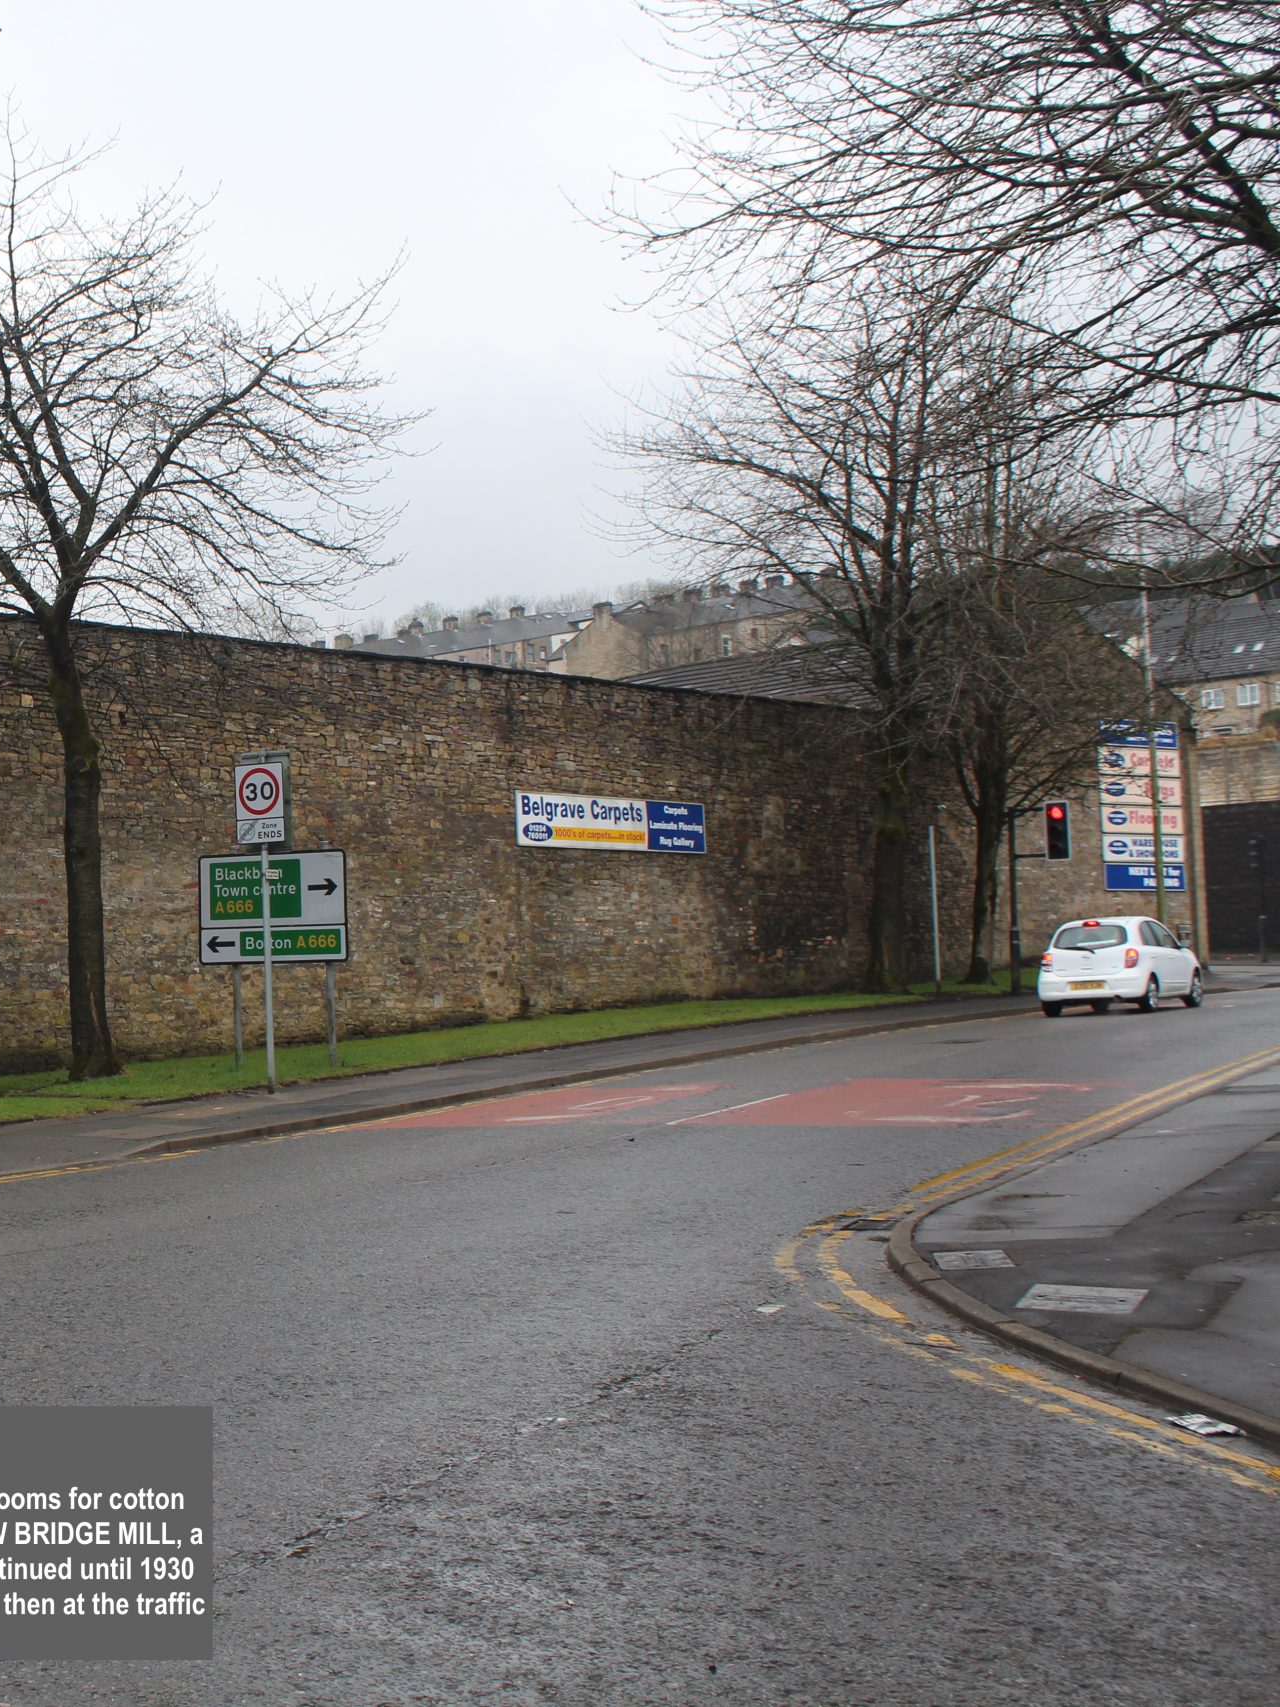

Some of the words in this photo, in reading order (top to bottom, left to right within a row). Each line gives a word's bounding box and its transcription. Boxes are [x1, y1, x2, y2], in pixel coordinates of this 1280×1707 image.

[245, 782, 273, 801] 30
[521, 795, 585, 821] Belgrave
[591, 799, 643, 824] Carpets
[664, 805, 688, 816] Carpets
[528, 824, 547, 832] 01254
[555, 828, 577, 837] 1000's
[578, 830, 585, 838] of
[678, 822, 703, 834] Flooring
[257, 830, 283, 839] ENDS
[527, 832, 549, 840] 760011
[659, 836, 672, 847] Rug
[673, 837, 695, 848] Gallery
[214, 884, 248, 897] Town
[245, 936, 292, 950] Boton
